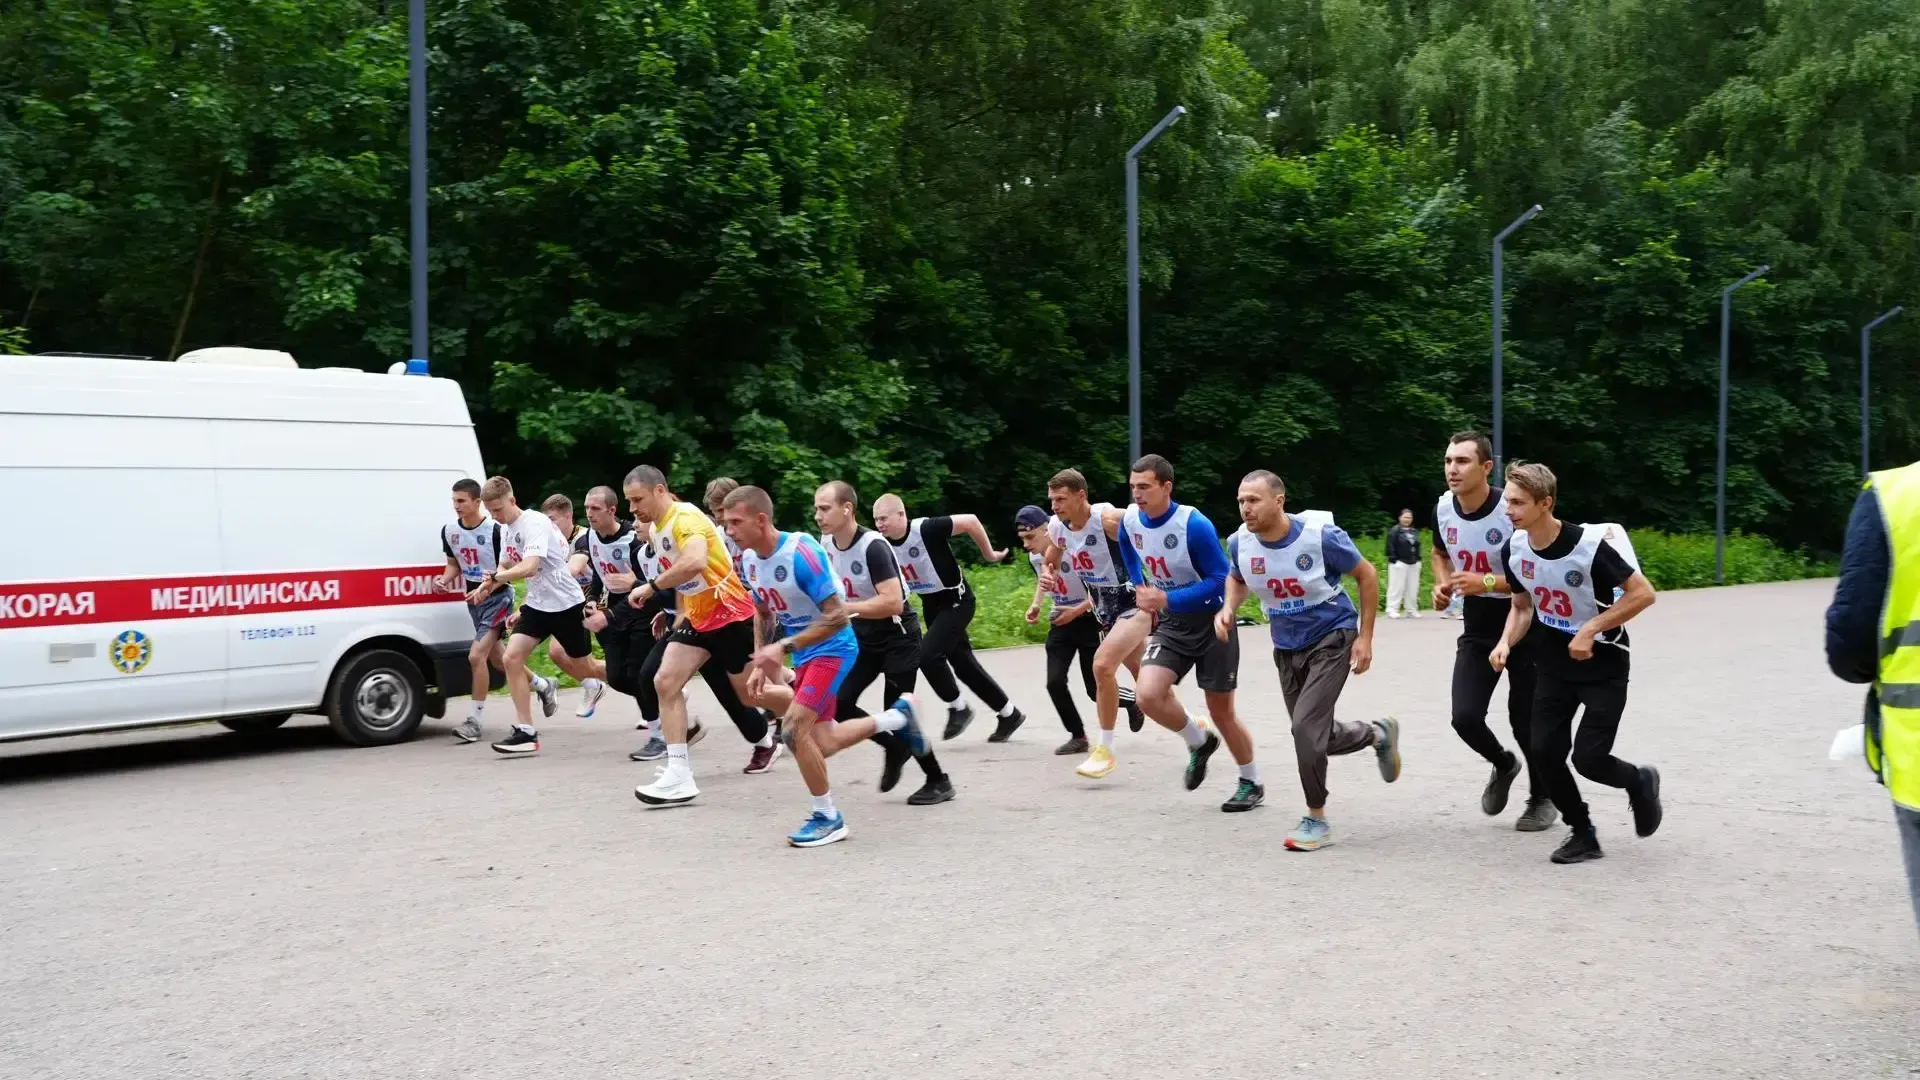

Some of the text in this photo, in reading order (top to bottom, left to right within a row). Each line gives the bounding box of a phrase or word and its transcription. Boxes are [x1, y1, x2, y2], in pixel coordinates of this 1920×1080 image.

[1145, 556, 1172, 580] 21
[1458, 550, 1492, 574] 24
[151, 579, 340, 613] МЕДИЦИНСКАЯ
[1267, 578, 1305, 599] 25
[1534, 586, 1572, 617] 23
[240, 624, 317, 641] ТЕЛЕФОН 112
